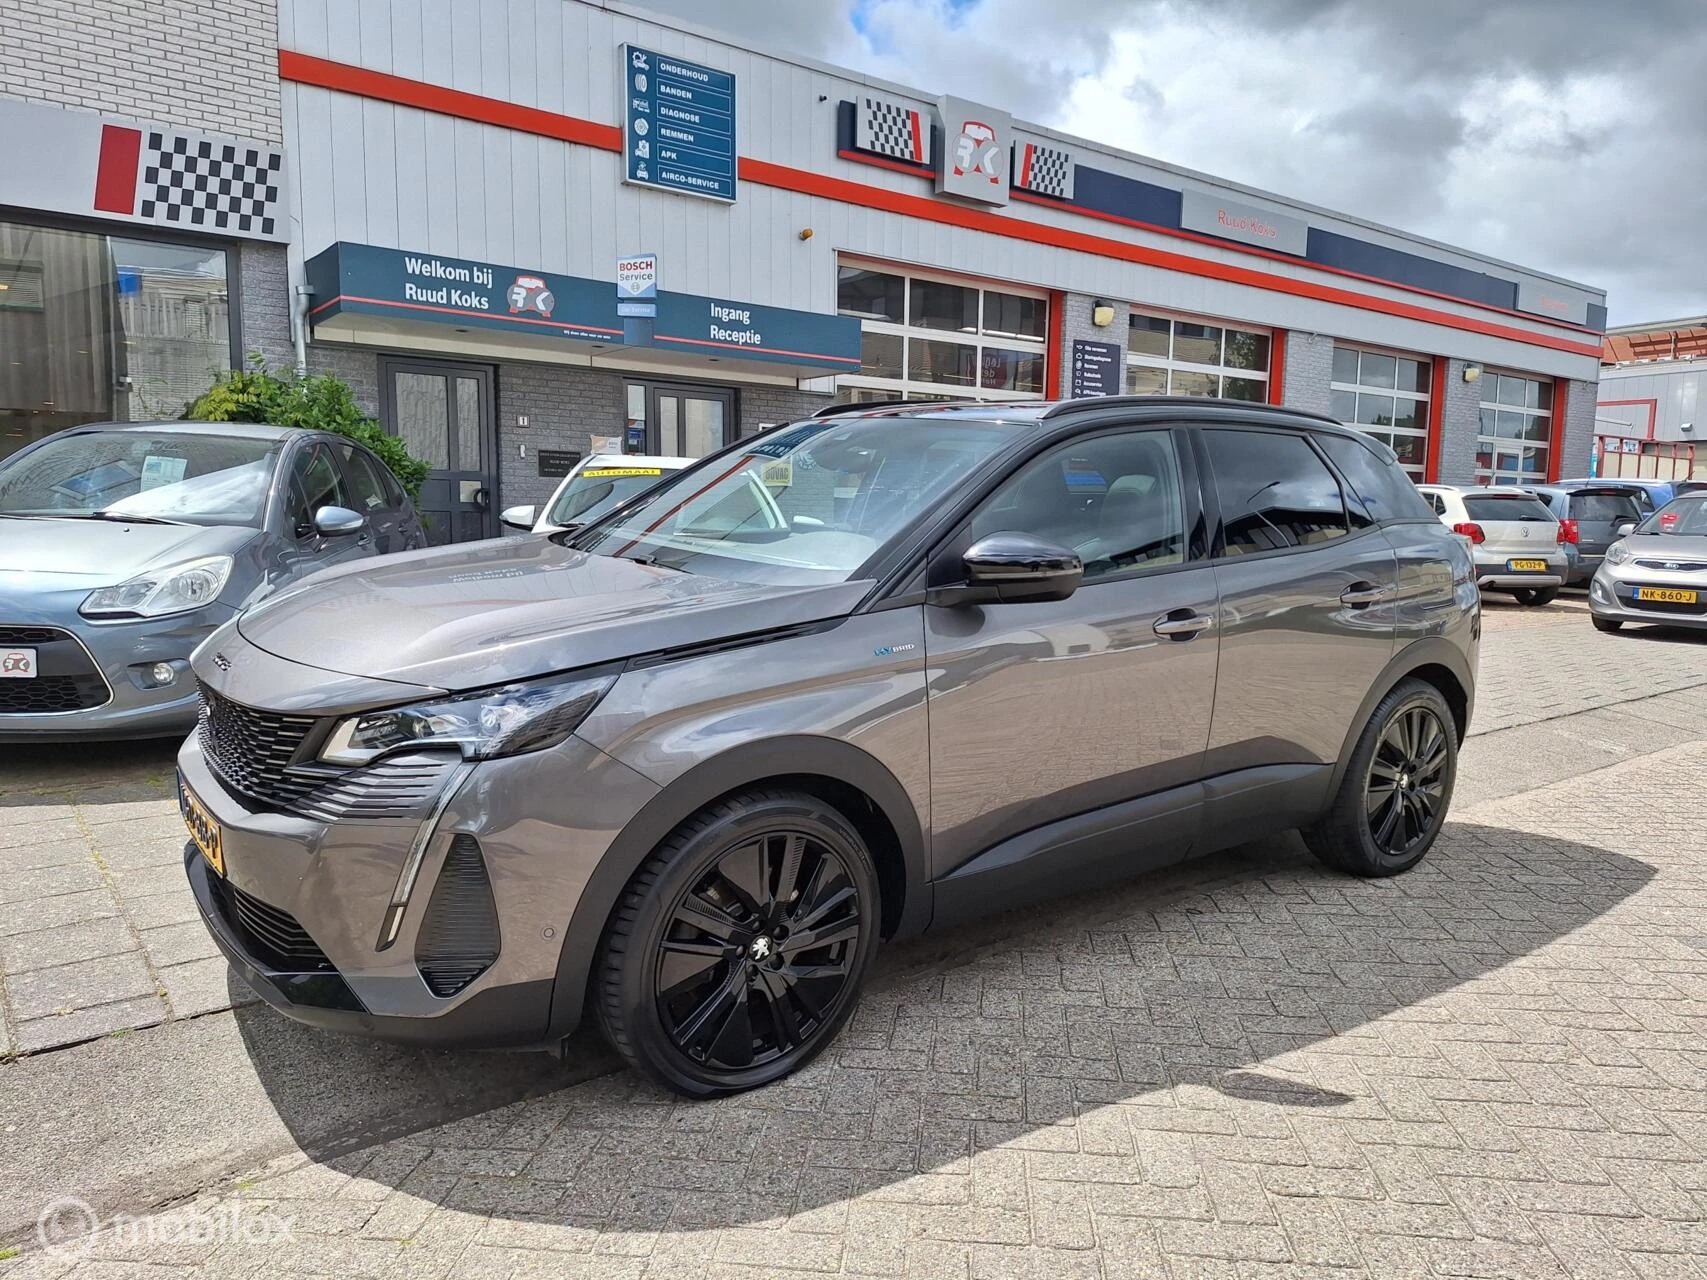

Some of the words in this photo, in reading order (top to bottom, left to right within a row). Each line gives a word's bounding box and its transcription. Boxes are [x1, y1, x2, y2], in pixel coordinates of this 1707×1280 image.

[660, 63, 709, 82] ONDERHOUD
[660, 85, 692, 99] BANDEN
[660, 107, 700, 123] DIAGNOSE
[660, 128, 694, 143] REMMEN
[661, 150, 677, 160] APK
[661, 171, 720, 189] AIRCO-SERVICE
[405, 256, 470, 282] Welkom
[473, 266, 493, 289] bij
[619, 260, 653, 272] BOSCH
[619, 273, 653, 281] Service
[405, 283, 447, 305] Ruud
[451, 289, 489, 309] Koks
[710, 302, 751, 325] Ingang
[710, 324, 761, 345] Receptie
[588, 469, 657, 477] AUTOMAAT
[1641, 589, 1692, 602] NK-860-J
